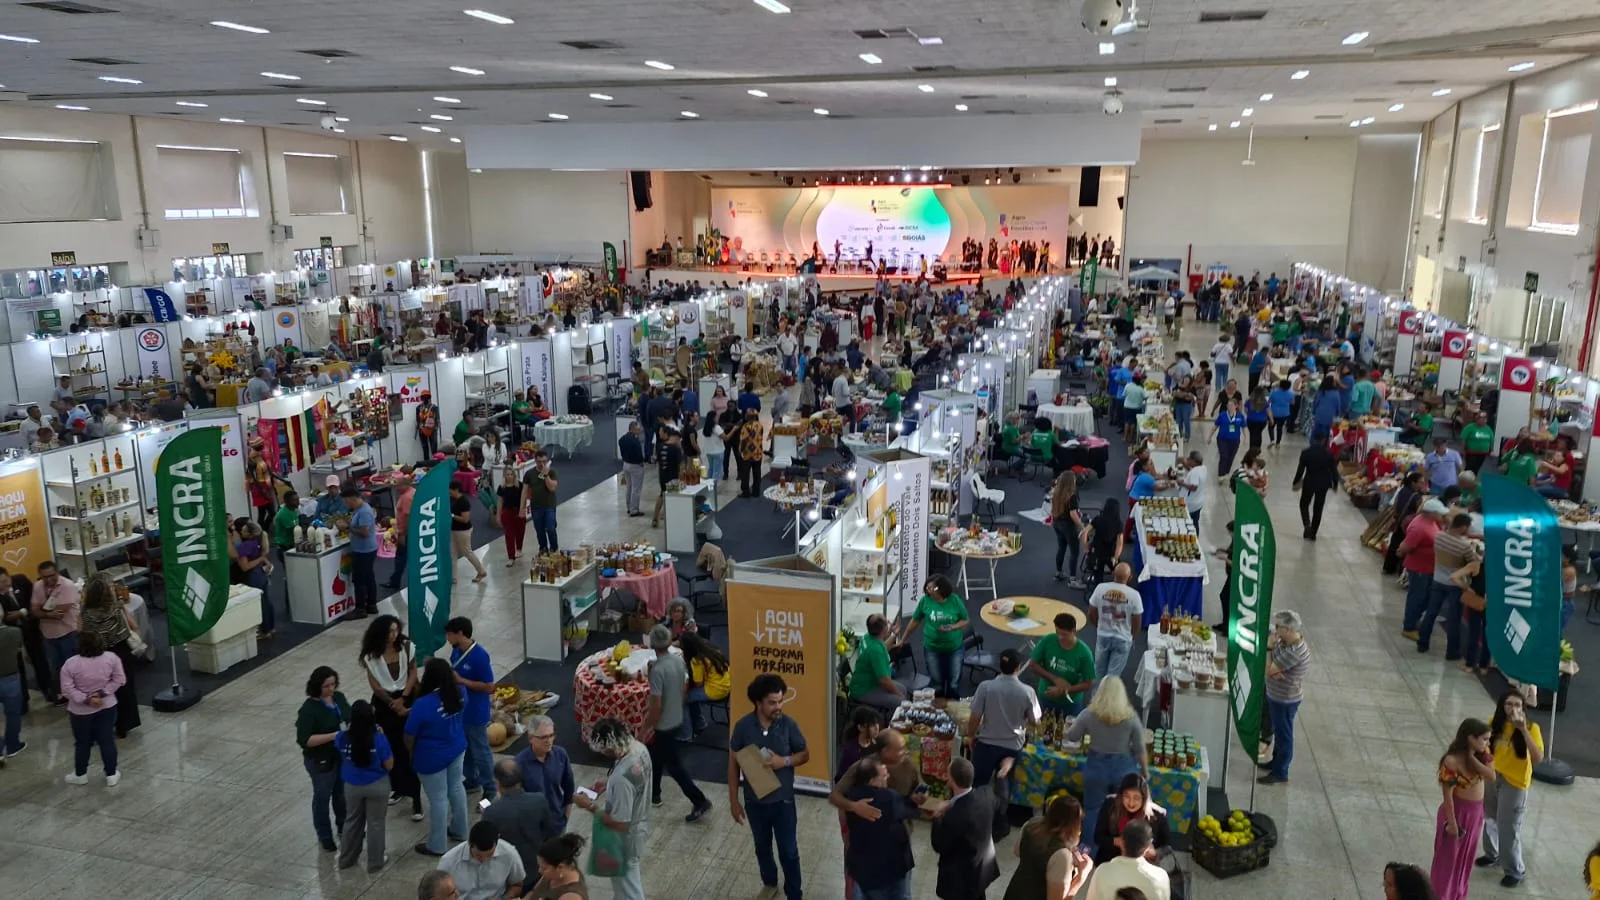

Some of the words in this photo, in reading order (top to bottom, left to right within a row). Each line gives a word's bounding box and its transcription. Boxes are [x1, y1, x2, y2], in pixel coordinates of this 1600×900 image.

[169, 456, 208, 564] INCRA
[913, 472, 922, 503] Saltos
[419, 497, 438, 584] INCRA
[1504, 518, 1534, 607] INCRA
[911, 532, 920, 602] Assentamento
[1235, 523, 1260, 654] INCRA
[328, 596, 356, 618] FETA
[765, 609, 803, 628] AQUI
[753, 646, 804, 661] REFORMA
[765, 627, 803, 648] TEM
